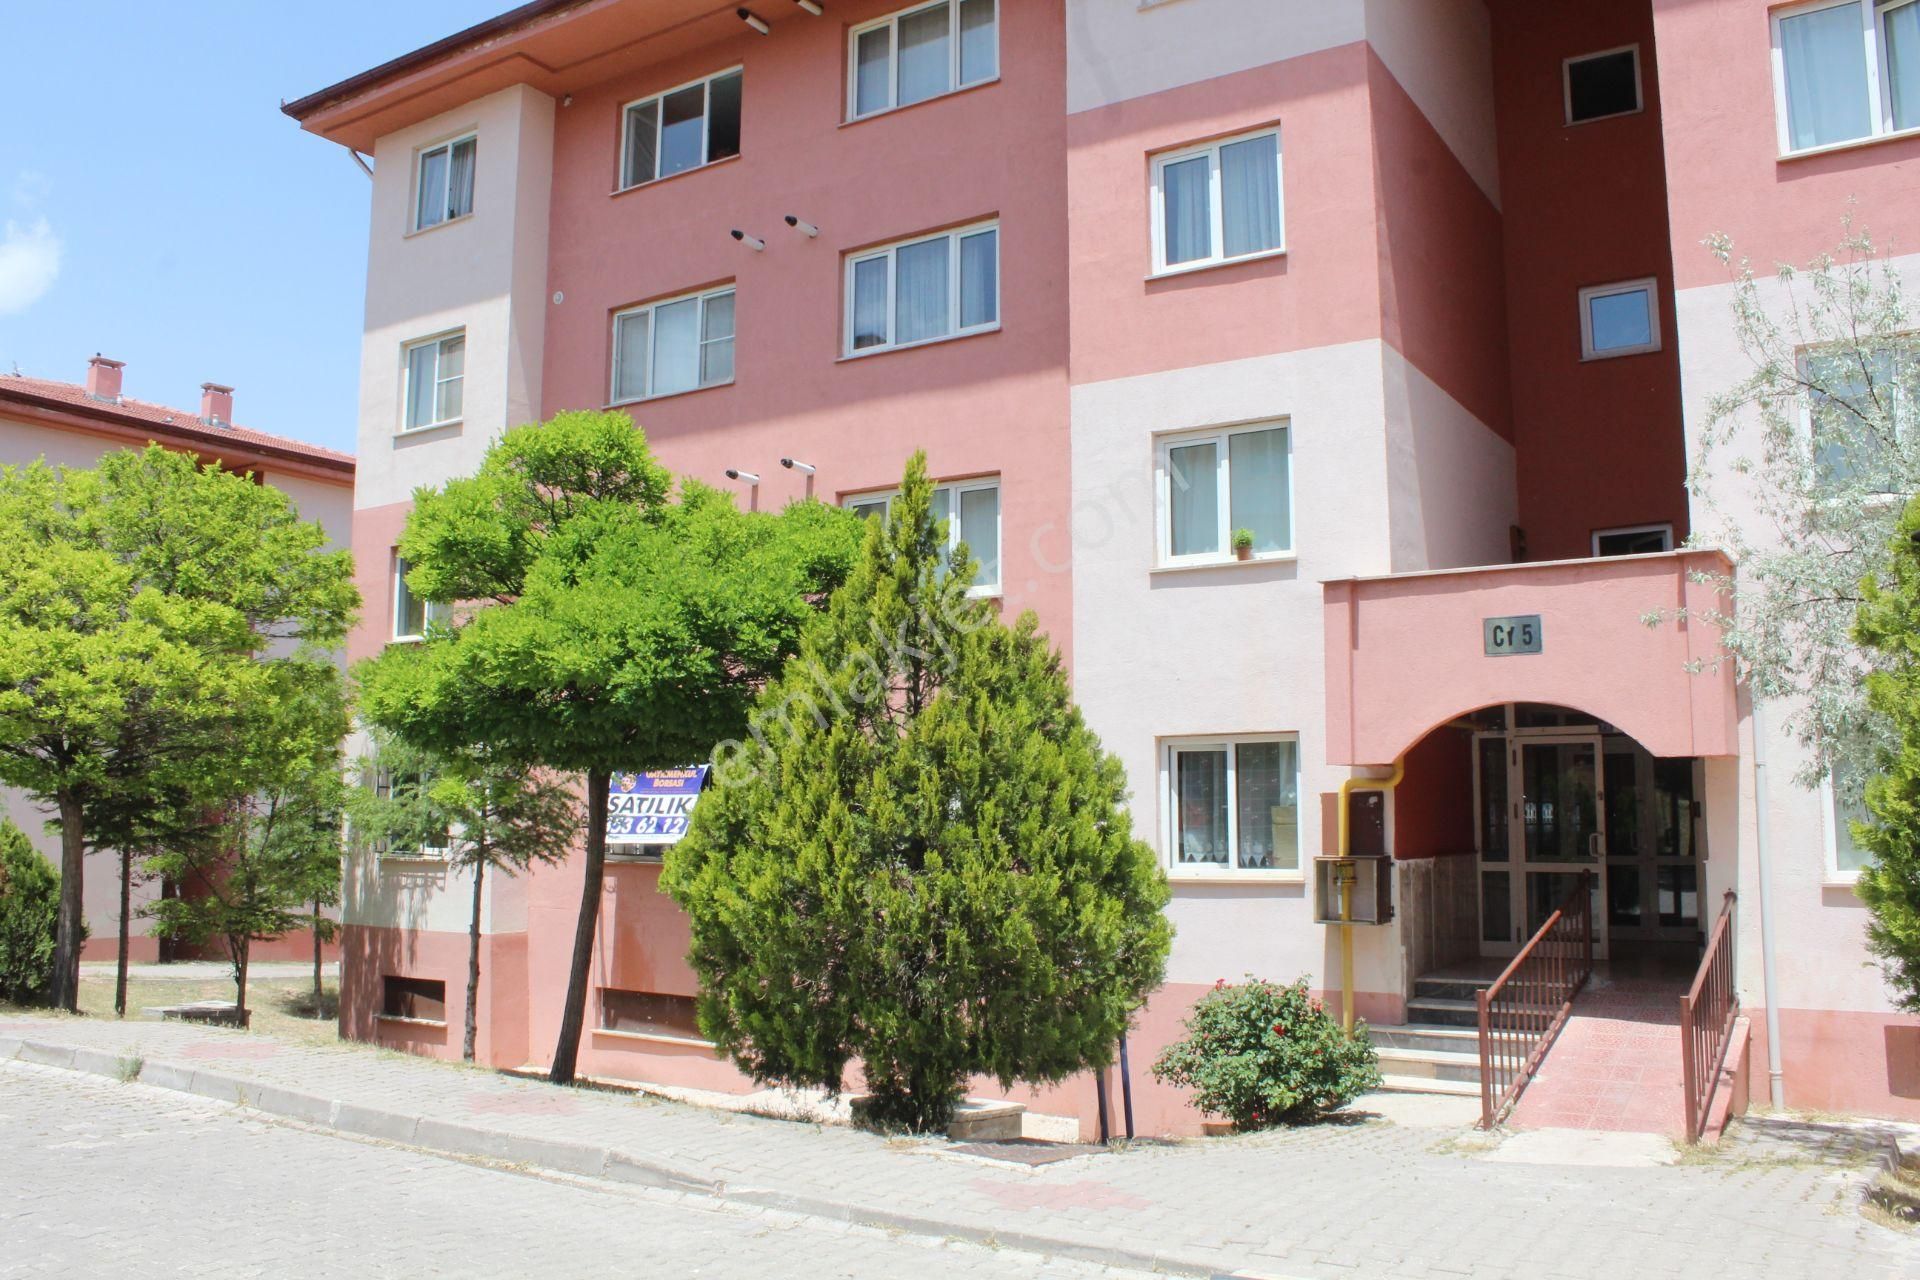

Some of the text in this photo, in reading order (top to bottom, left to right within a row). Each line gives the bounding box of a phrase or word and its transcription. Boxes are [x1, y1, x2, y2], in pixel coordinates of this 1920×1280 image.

[1522, 624, 1533, 646] 5
[608, 795, 692, 814] SATILIK
[636, 816, 658, 834] 62
[662, 816, 685, 834] 12
